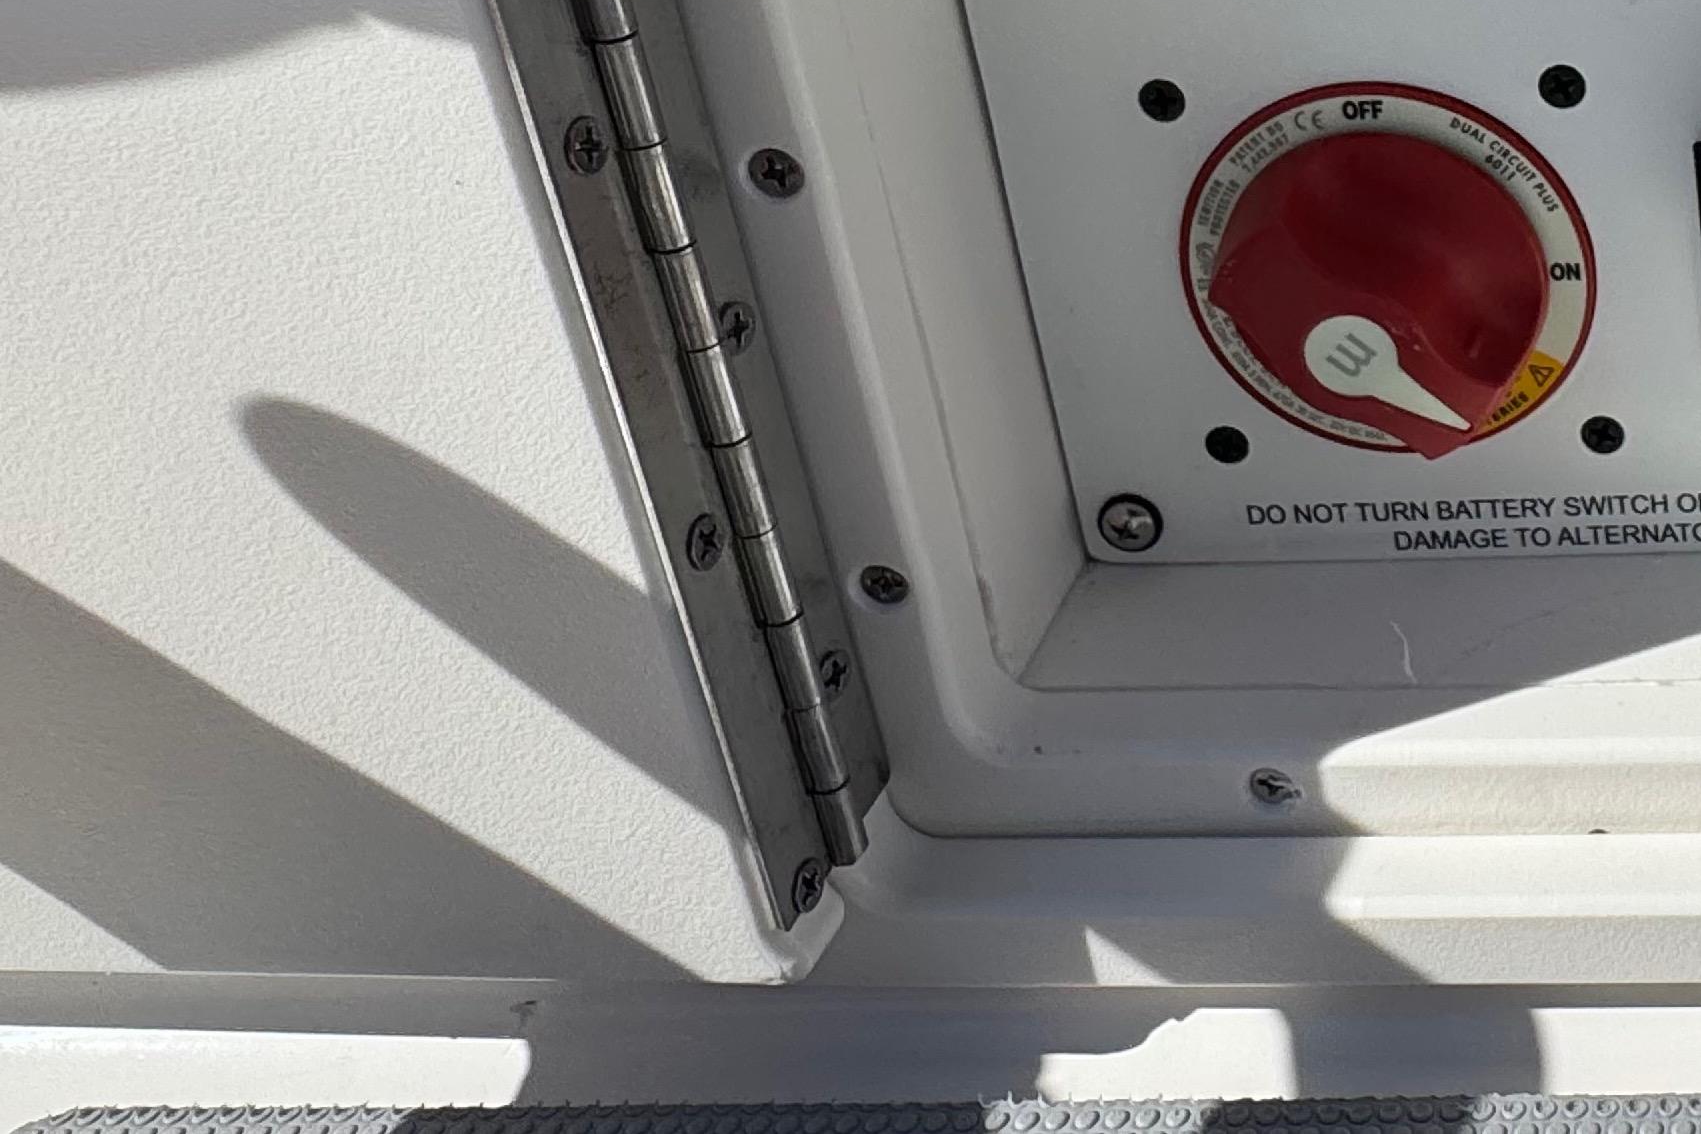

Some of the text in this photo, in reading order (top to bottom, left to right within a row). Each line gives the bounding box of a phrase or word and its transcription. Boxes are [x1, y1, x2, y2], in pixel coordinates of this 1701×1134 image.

[1341, 100, 1384, 121] OFF
[1449, 117, 1559, 213] DUAL CIRCUIT PLUS
[1484, 153, 1516, 182] 6011
[1550, 262, 1582, 282] ON
[1247, 504, 1286, 525] DO
[1294, 502, 1348, 524] NOT
[1354, 500, 1430, 523] TURN
[1436, 497, 1555, 521] BATTERY
[1563, 494, 1669, 516] SWITCH
[1394, 528, 1509, 551] DAMAGE
[1513, 526, 1552, 547] TO
